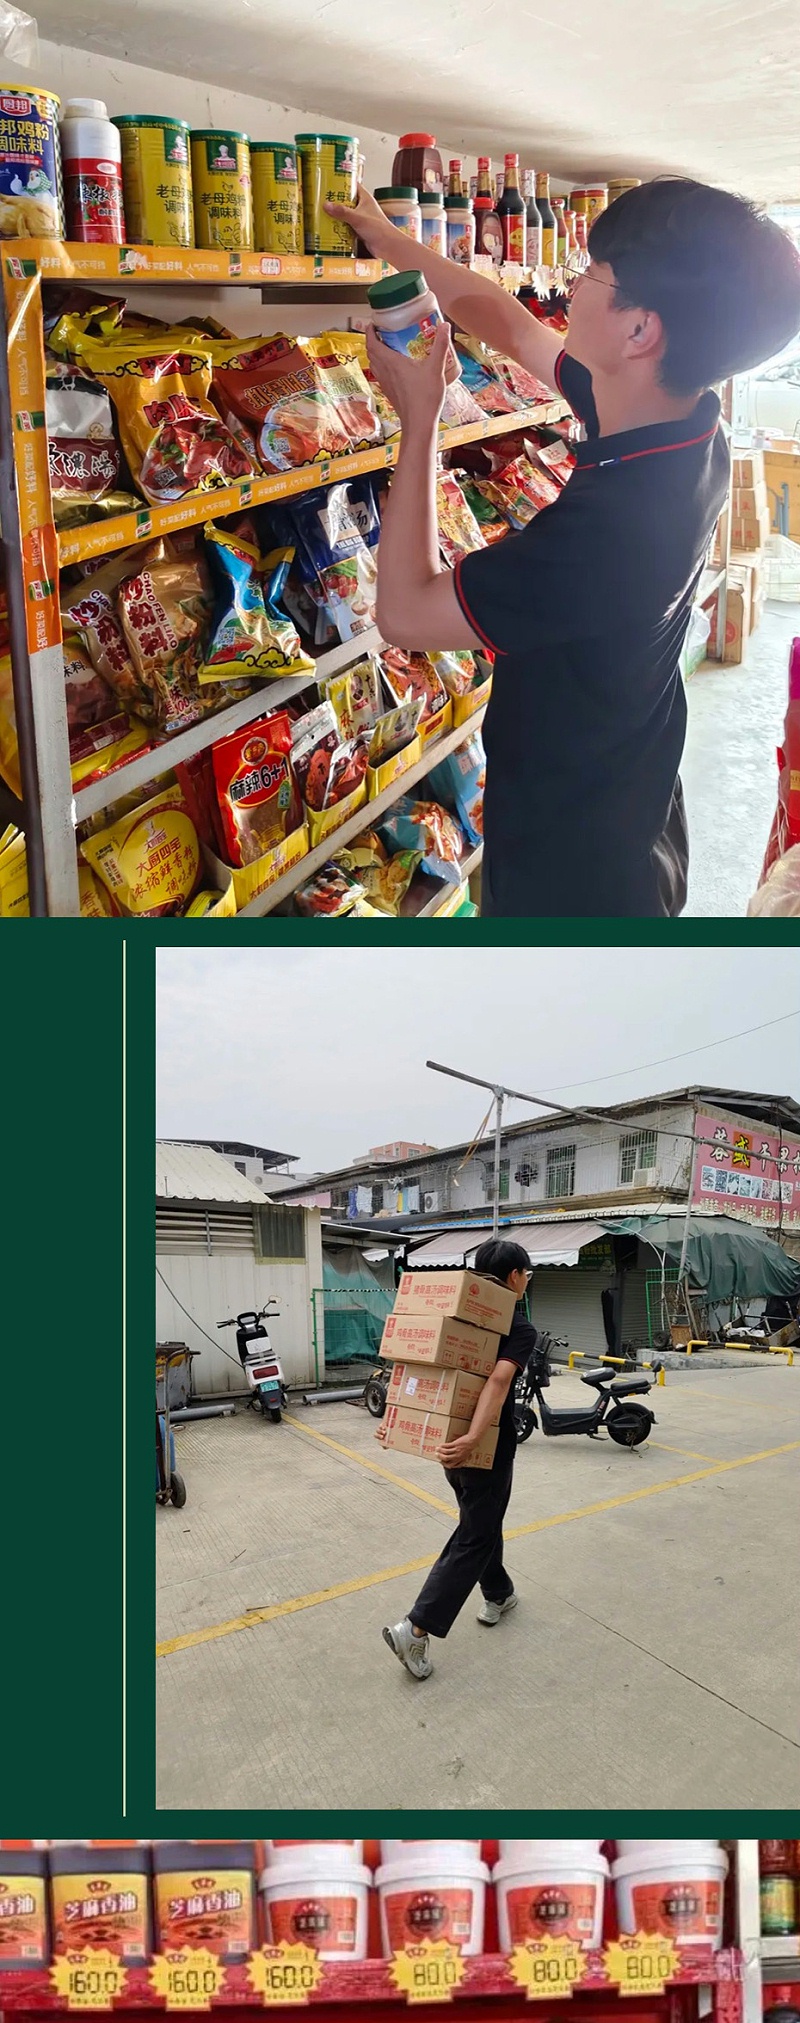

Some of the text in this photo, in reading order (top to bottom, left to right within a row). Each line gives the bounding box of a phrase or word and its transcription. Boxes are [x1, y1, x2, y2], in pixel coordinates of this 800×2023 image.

[229, 755, 290, 804] 麻辣6+1
[65, 1890, 138, 1922] 芝麻香油
[168, 1889, 242, 1920] 芝麻香油
